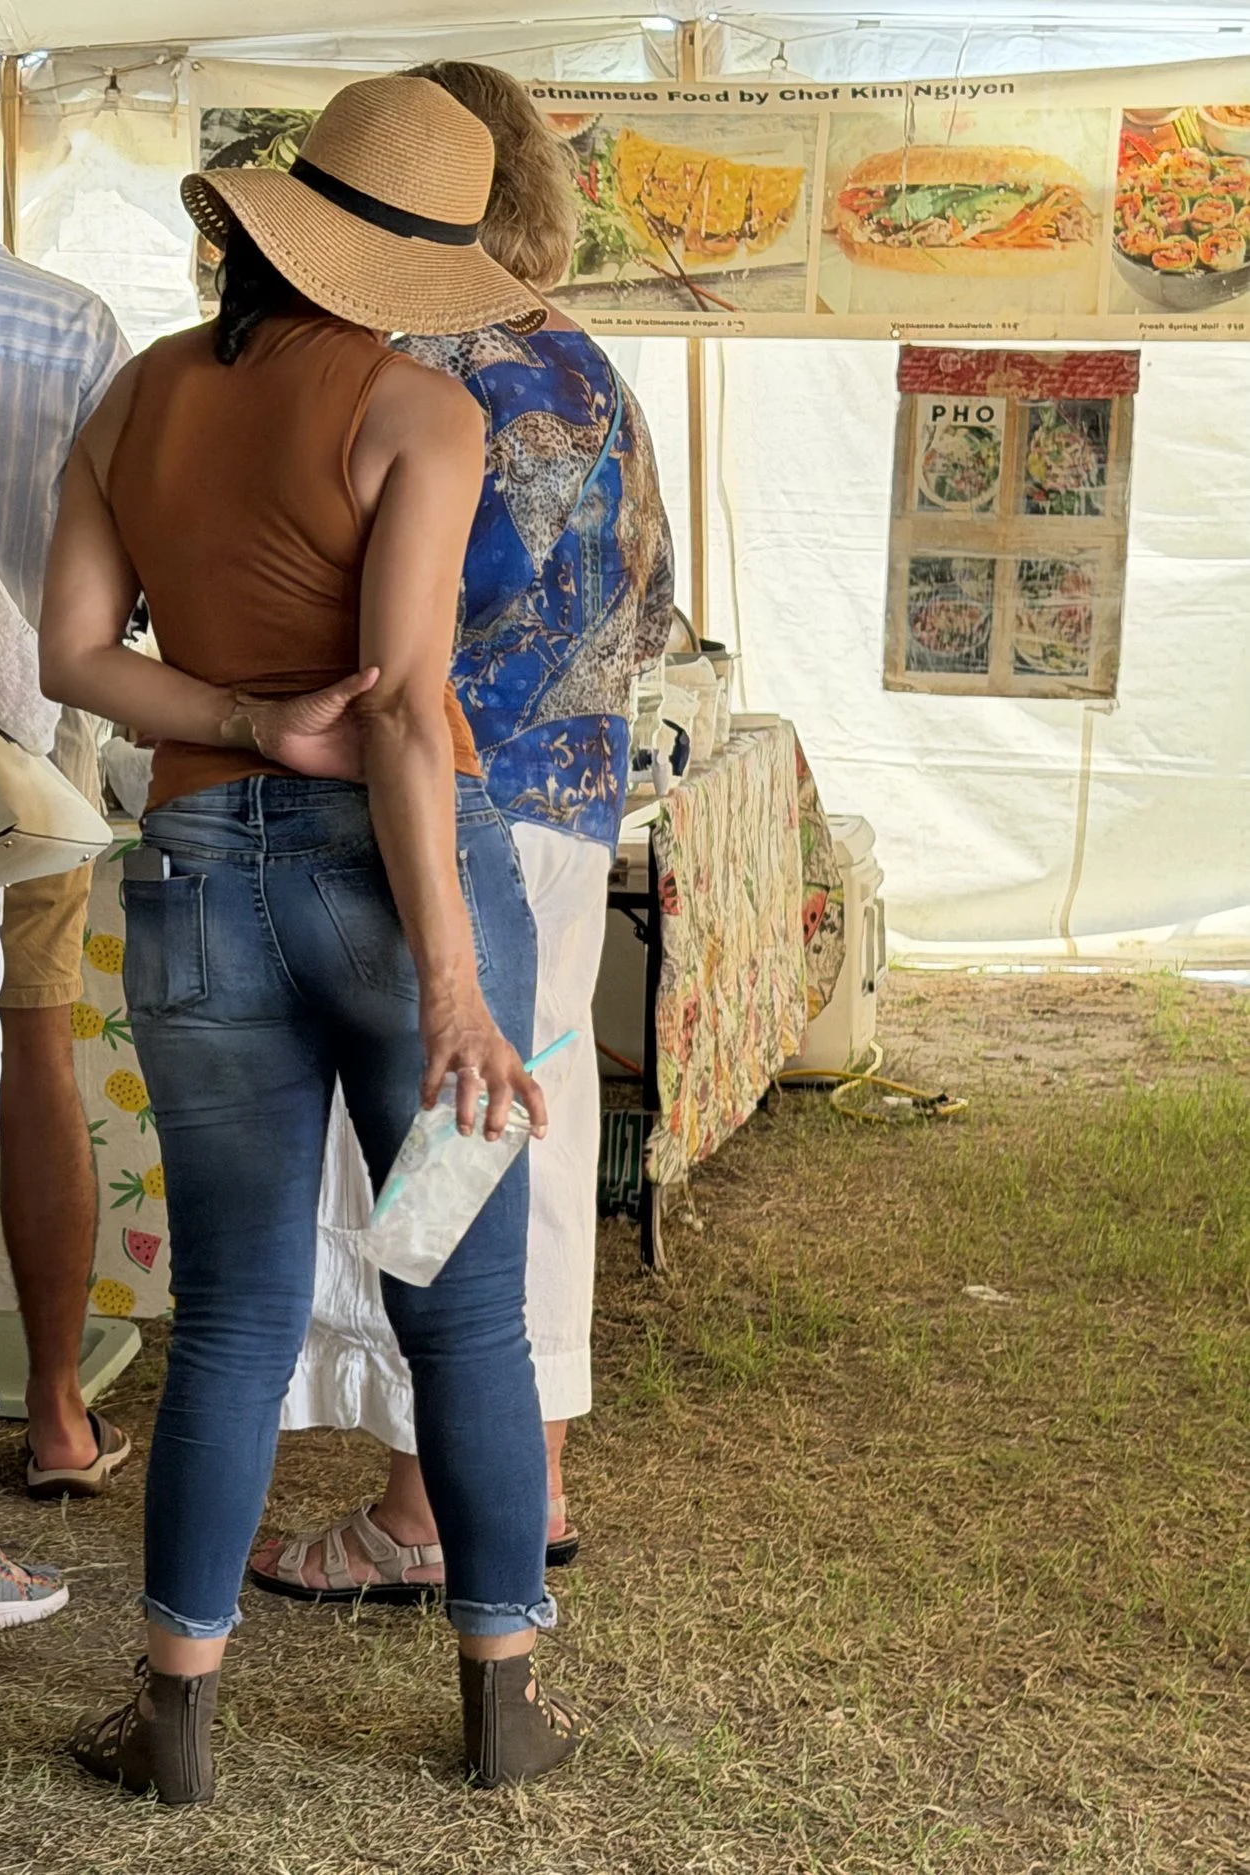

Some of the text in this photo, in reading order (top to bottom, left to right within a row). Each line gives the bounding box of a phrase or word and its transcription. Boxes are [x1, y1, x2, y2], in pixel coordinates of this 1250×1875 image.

[668, 90, 729, 102] Food
[739, 90, 769, 105] by
[779, 88, 841, 101] Chef
[850, 87, 903, 99] Kim
[931, 405, 995, 423] PHO
